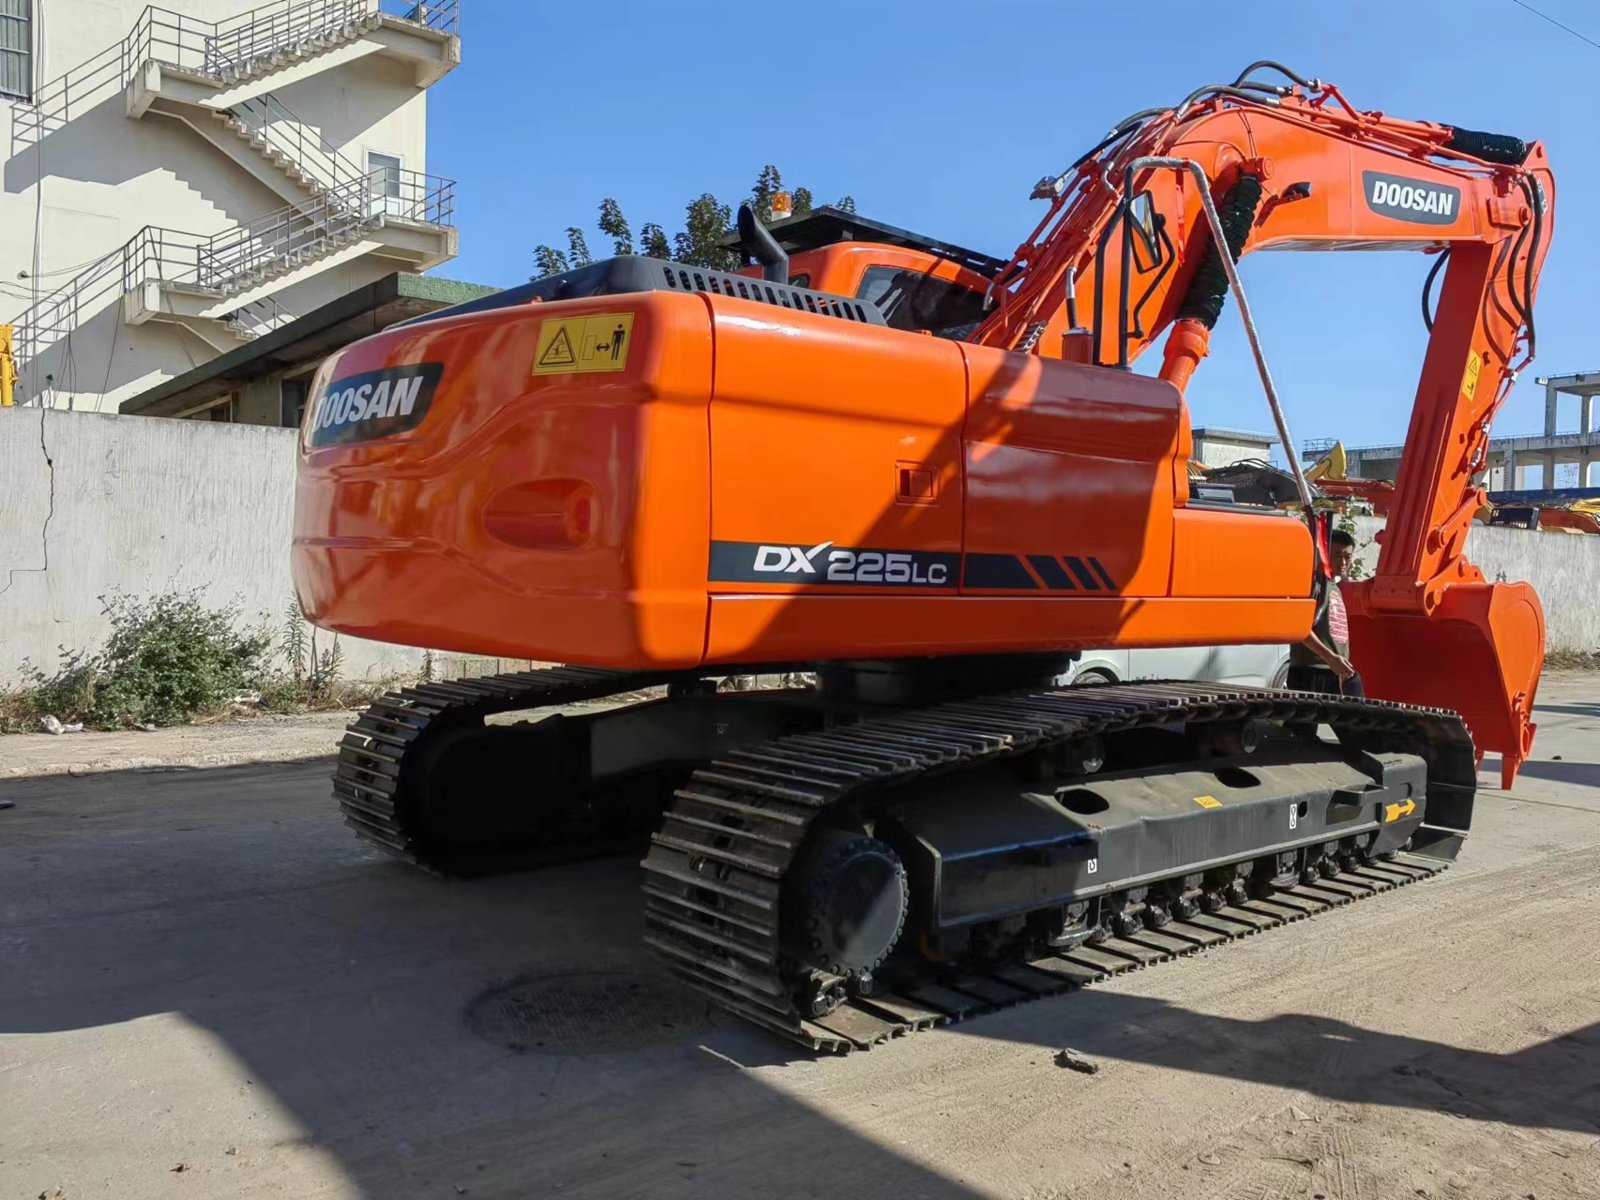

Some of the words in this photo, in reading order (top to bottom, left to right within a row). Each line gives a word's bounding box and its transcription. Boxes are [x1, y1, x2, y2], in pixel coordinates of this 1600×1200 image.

[1372, 181, 1453, 215] DOOSAN
[312, 376, 424, 432] DOOSAN
[753, 541, 834, 573] DX
